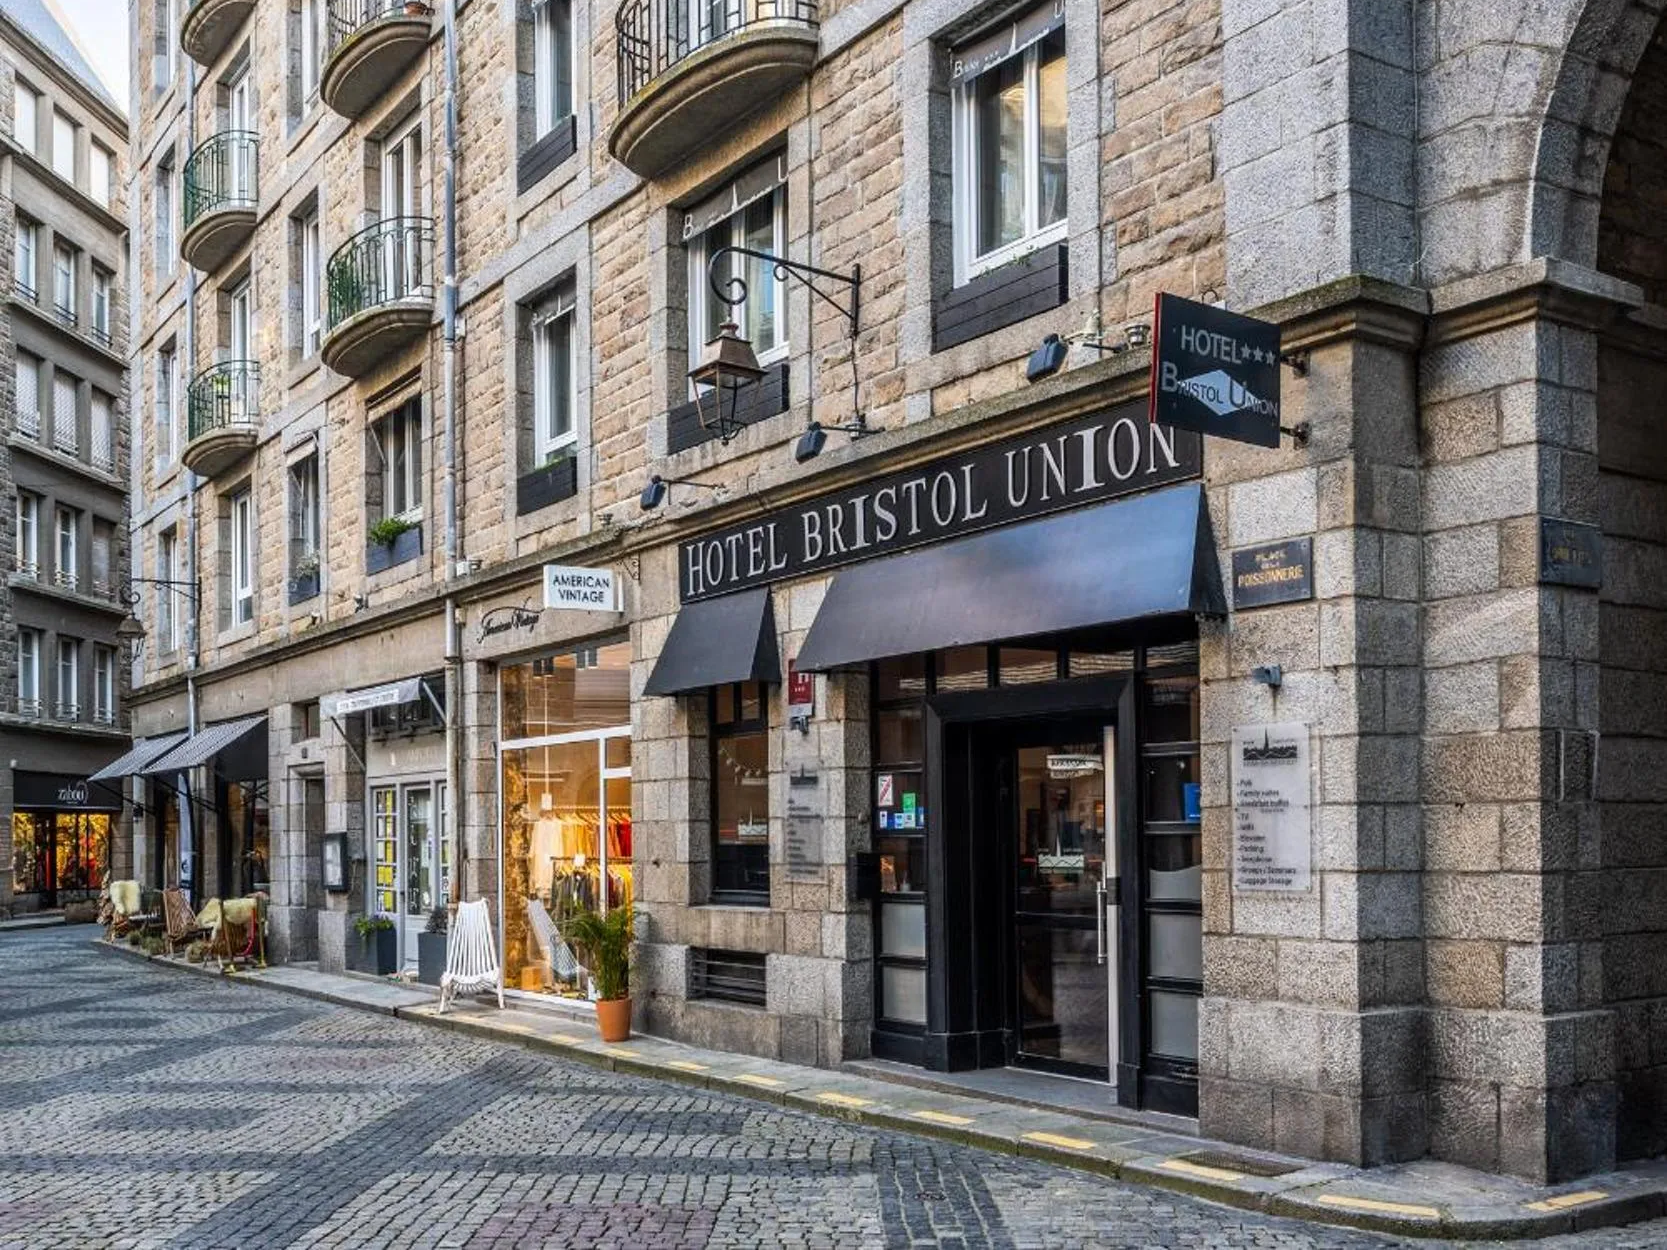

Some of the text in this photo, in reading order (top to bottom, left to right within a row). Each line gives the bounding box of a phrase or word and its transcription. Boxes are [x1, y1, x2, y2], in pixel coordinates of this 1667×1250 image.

[1180, 324, 1242, 364] HOTEL
[1161, 360, 1279, 418] BRISTOL UNION
[686, 417, 1181, 597] HOTEL BRISTOL UNION
[552, 574, 610, 589] AMERICAN
[558, 589, 605, 603] VINTAGE
